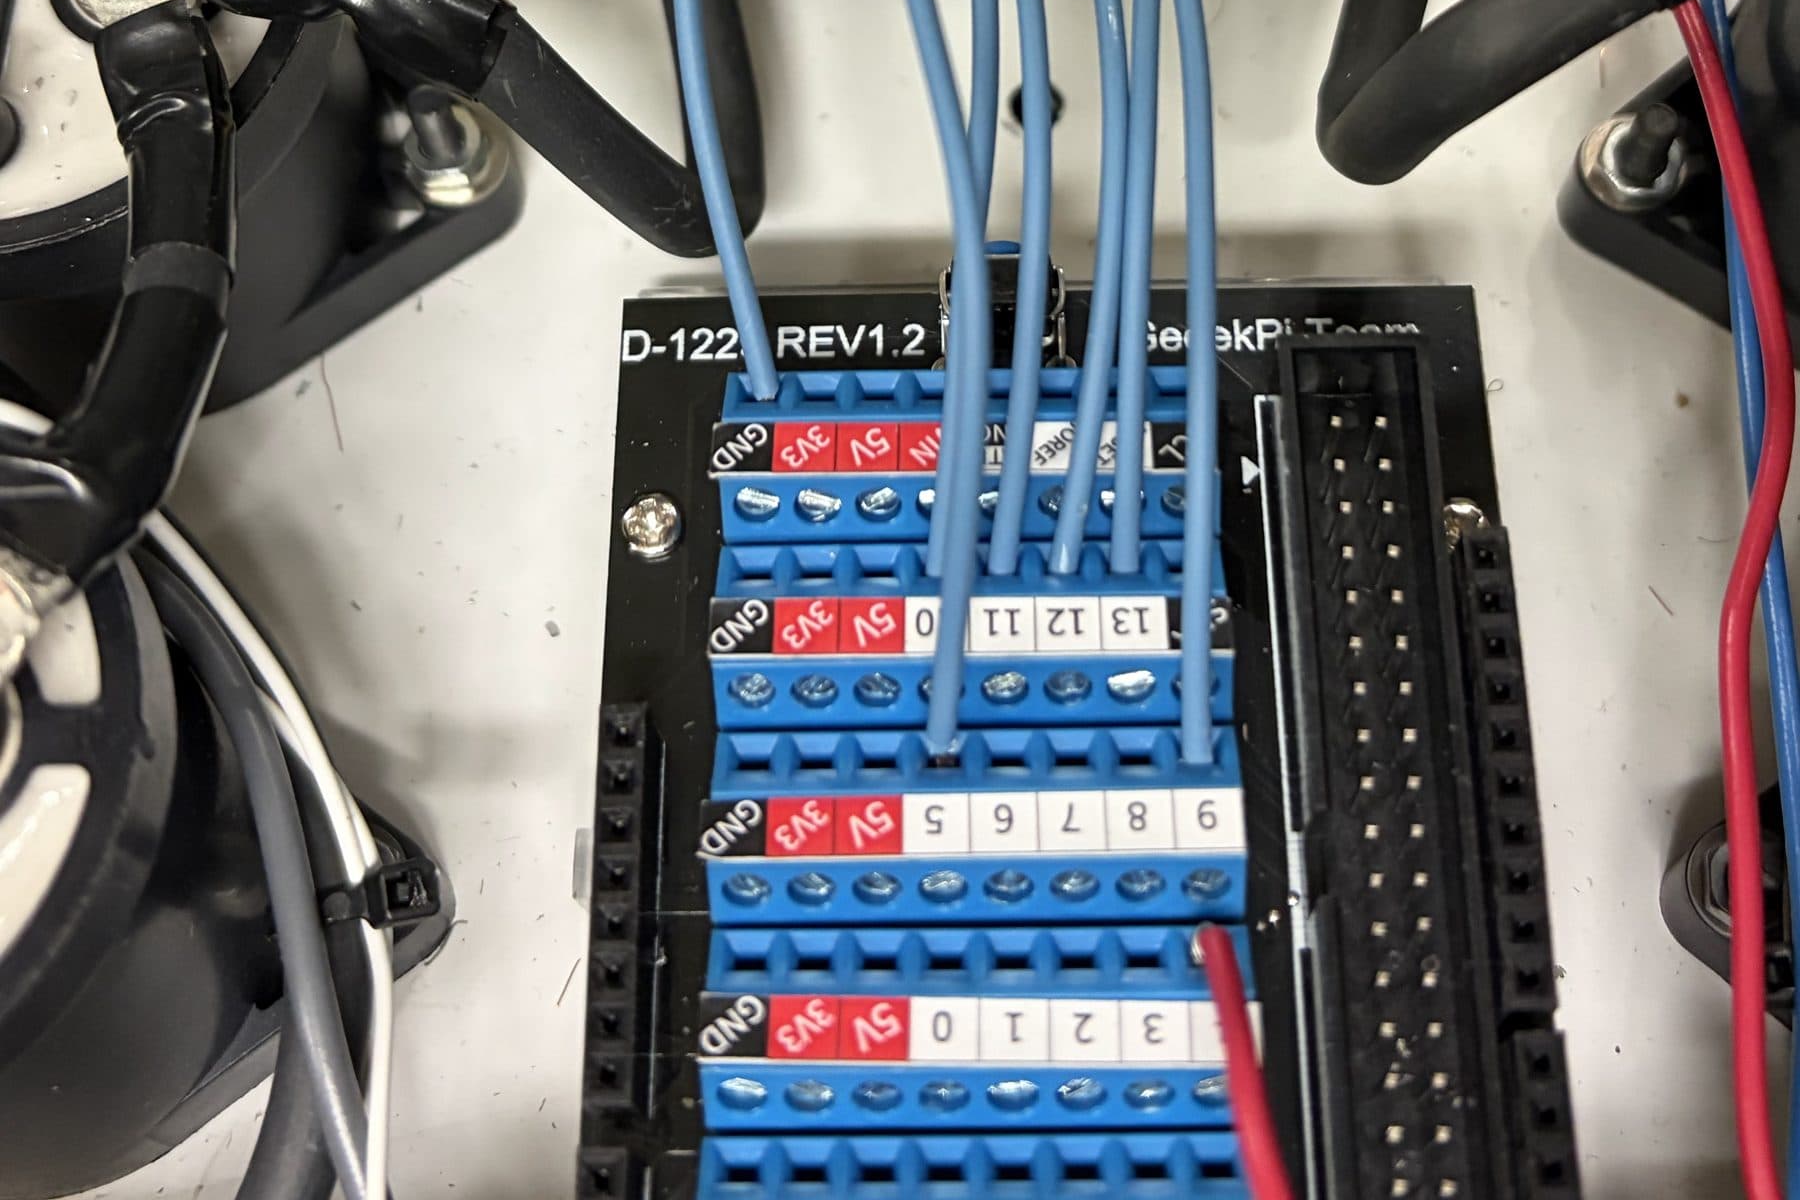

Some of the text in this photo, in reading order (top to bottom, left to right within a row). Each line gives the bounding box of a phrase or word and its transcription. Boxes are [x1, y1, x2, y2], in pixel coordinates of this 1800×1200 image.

[622, 323, 925, 362] D-122 REV1.2
[712, 423, 768, 469] GND
[780, 425, 830, 468] 3V3
[850, 428, 891, 466] 5V
[909, 428, 941, 466] IN
[711, 599, 769, 651] GND
[782, 601, 833, 648] 3V3
[853, 602, 896, 647] 5V
[983, 608, 1020, 636] 11
[1047, 608, 1085, 636] 12
[1111, 607, 1149, 634] 13
[701, 799, 763, 854] GND
[774, 800, 829, 850] 3V3
[849, 801, 895, 849] 5V
[925, 805, 944, 834] 5
[994, 803, 1014, 834] 6
[1062, 802, 1081, 832] 7
[1127, 801, 1147, 831] 8
[1198, 800, 1217, 830] 9
[699, 995, 767, 1054] GND
[776, 998, 836, 1052] 3V3
[854, 1002, 902, 1053] 5V
[933, 1011, 952, 1042] 0
[1005, 1012, 1024, 1042] 1
[1073, 1013, 1094, 1043] 2
[1143, 1013, 1164, 1043] 3
